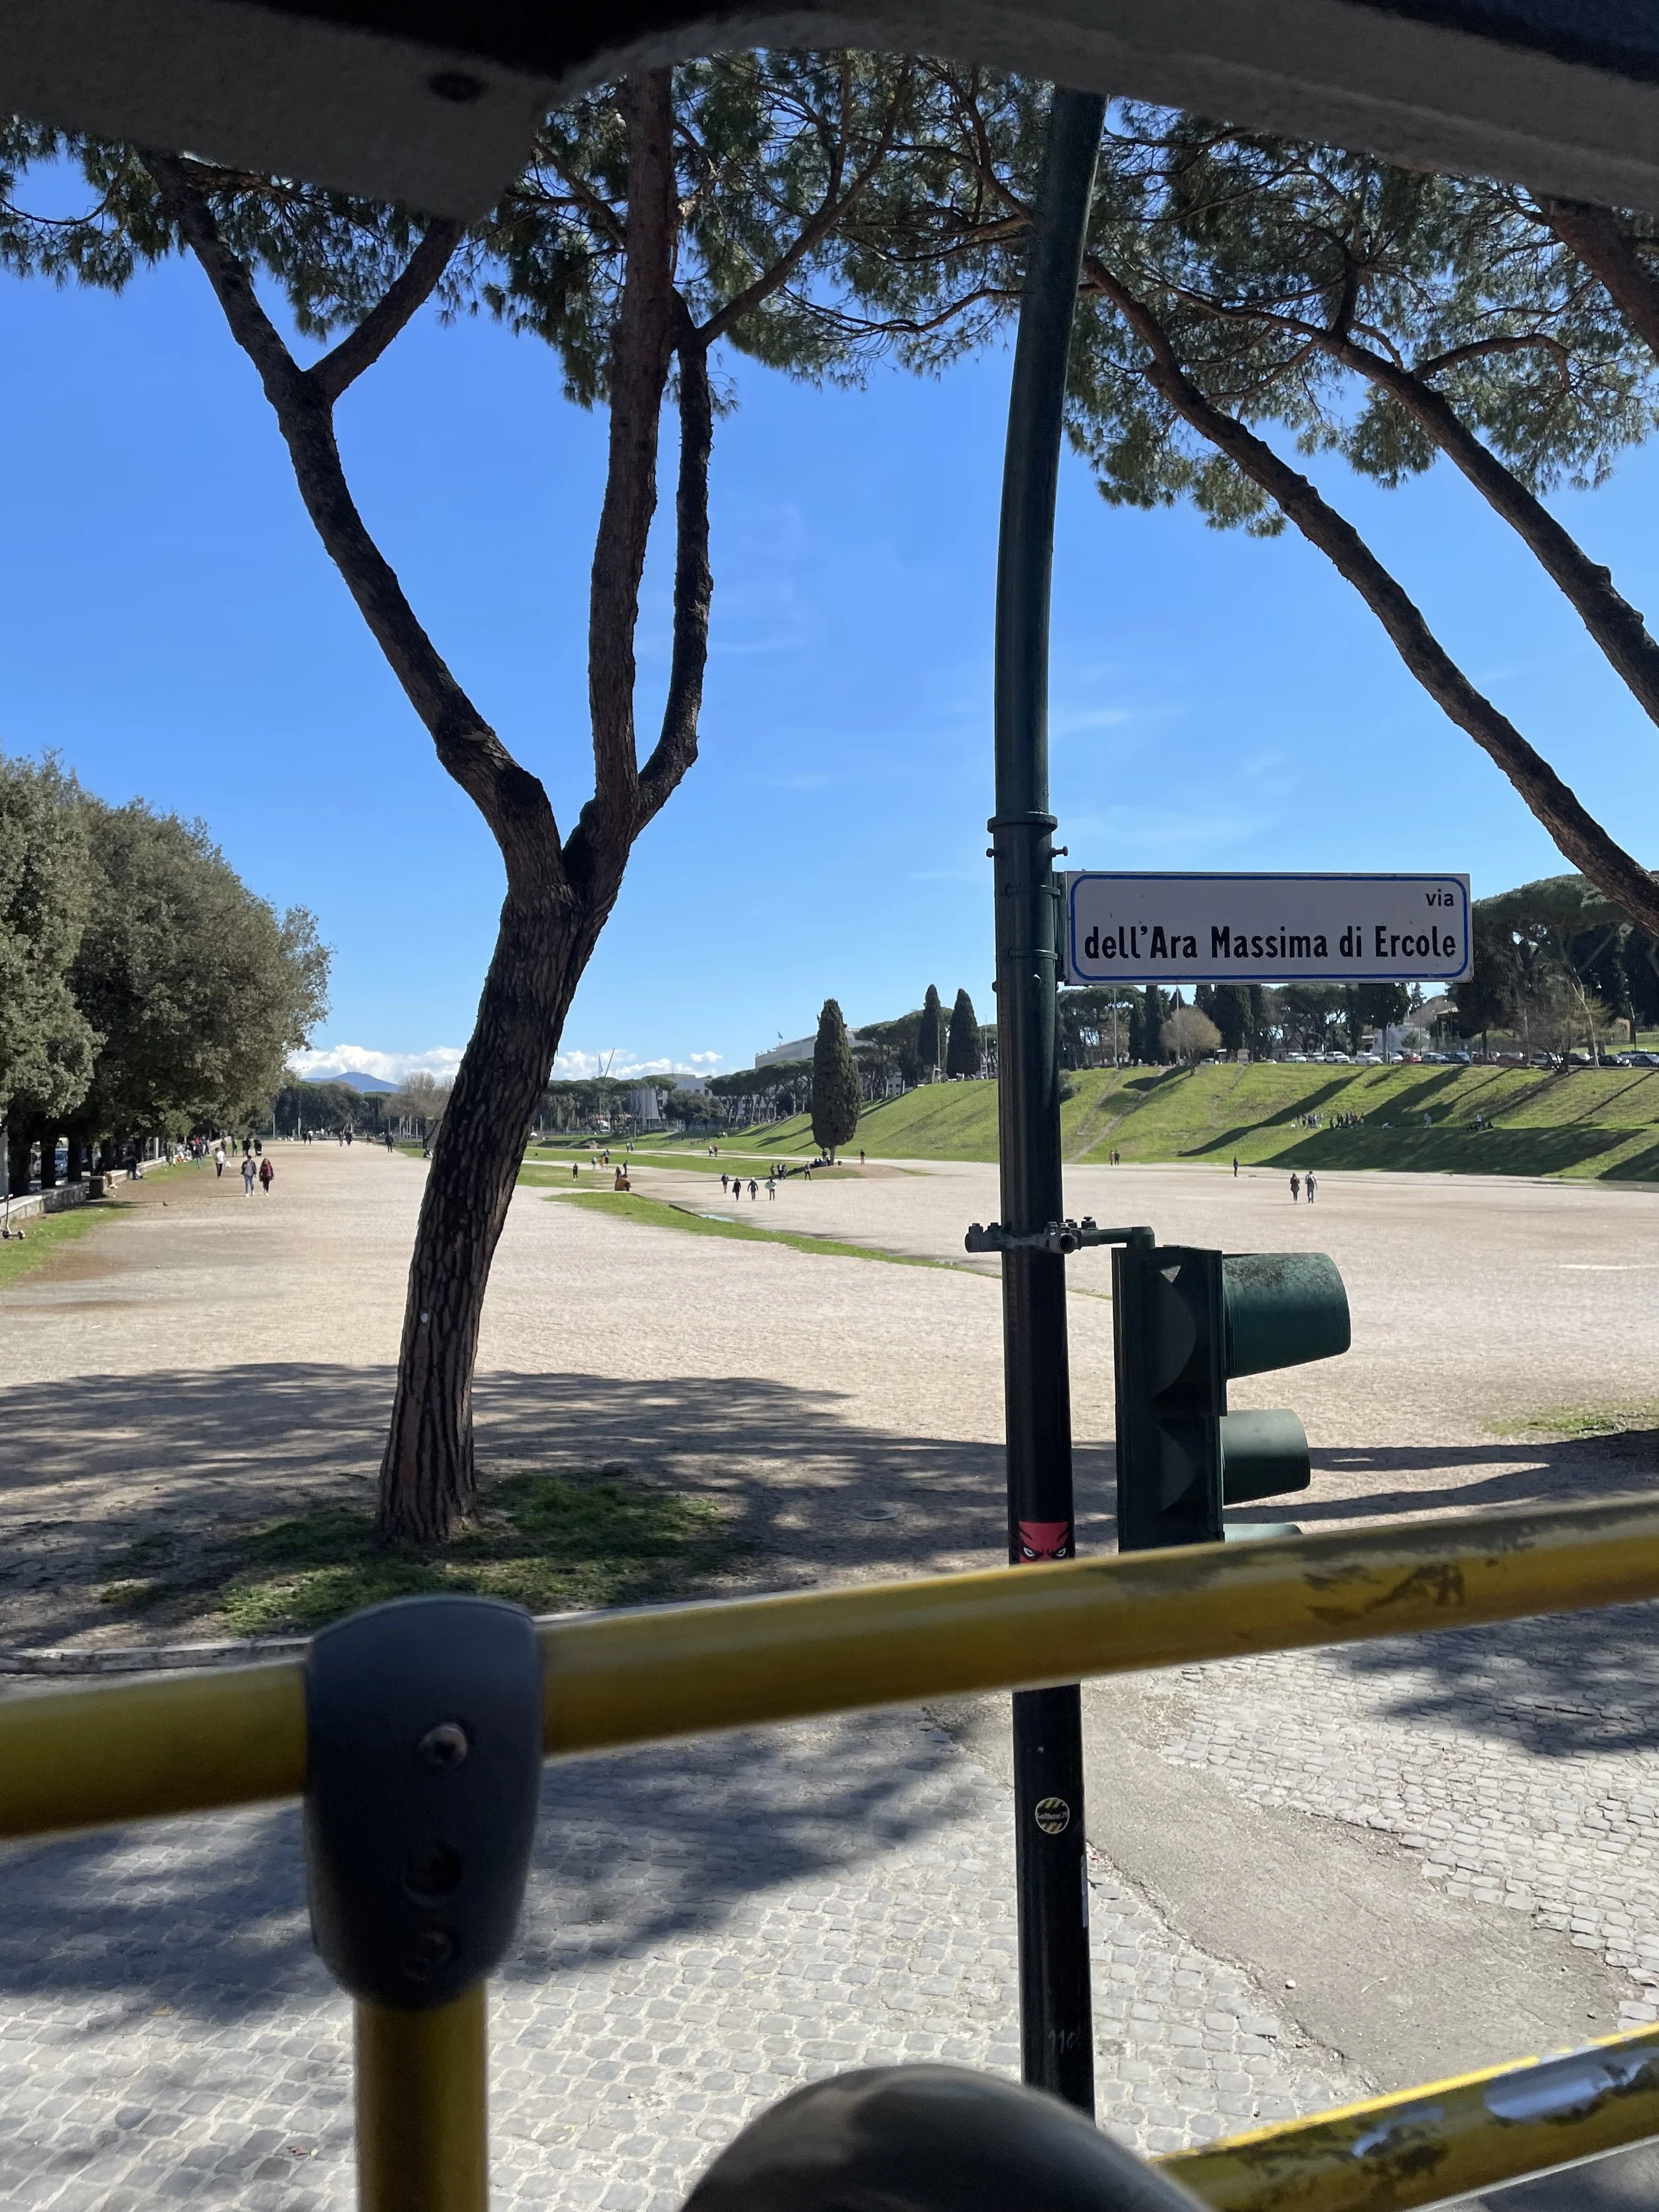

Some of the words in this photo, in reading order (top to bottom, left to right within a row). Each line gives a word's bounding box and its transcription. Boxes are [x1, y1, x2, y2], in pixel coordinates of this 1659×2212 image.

[1425, 889, 1455, 907] via
[1084, 925, 1199, 960] dell'Ara
[1210, 925, 1329, 959] Massima
[1339, 925, 1363, 958] di
[1374, 925, 1457, 958] Ercole
